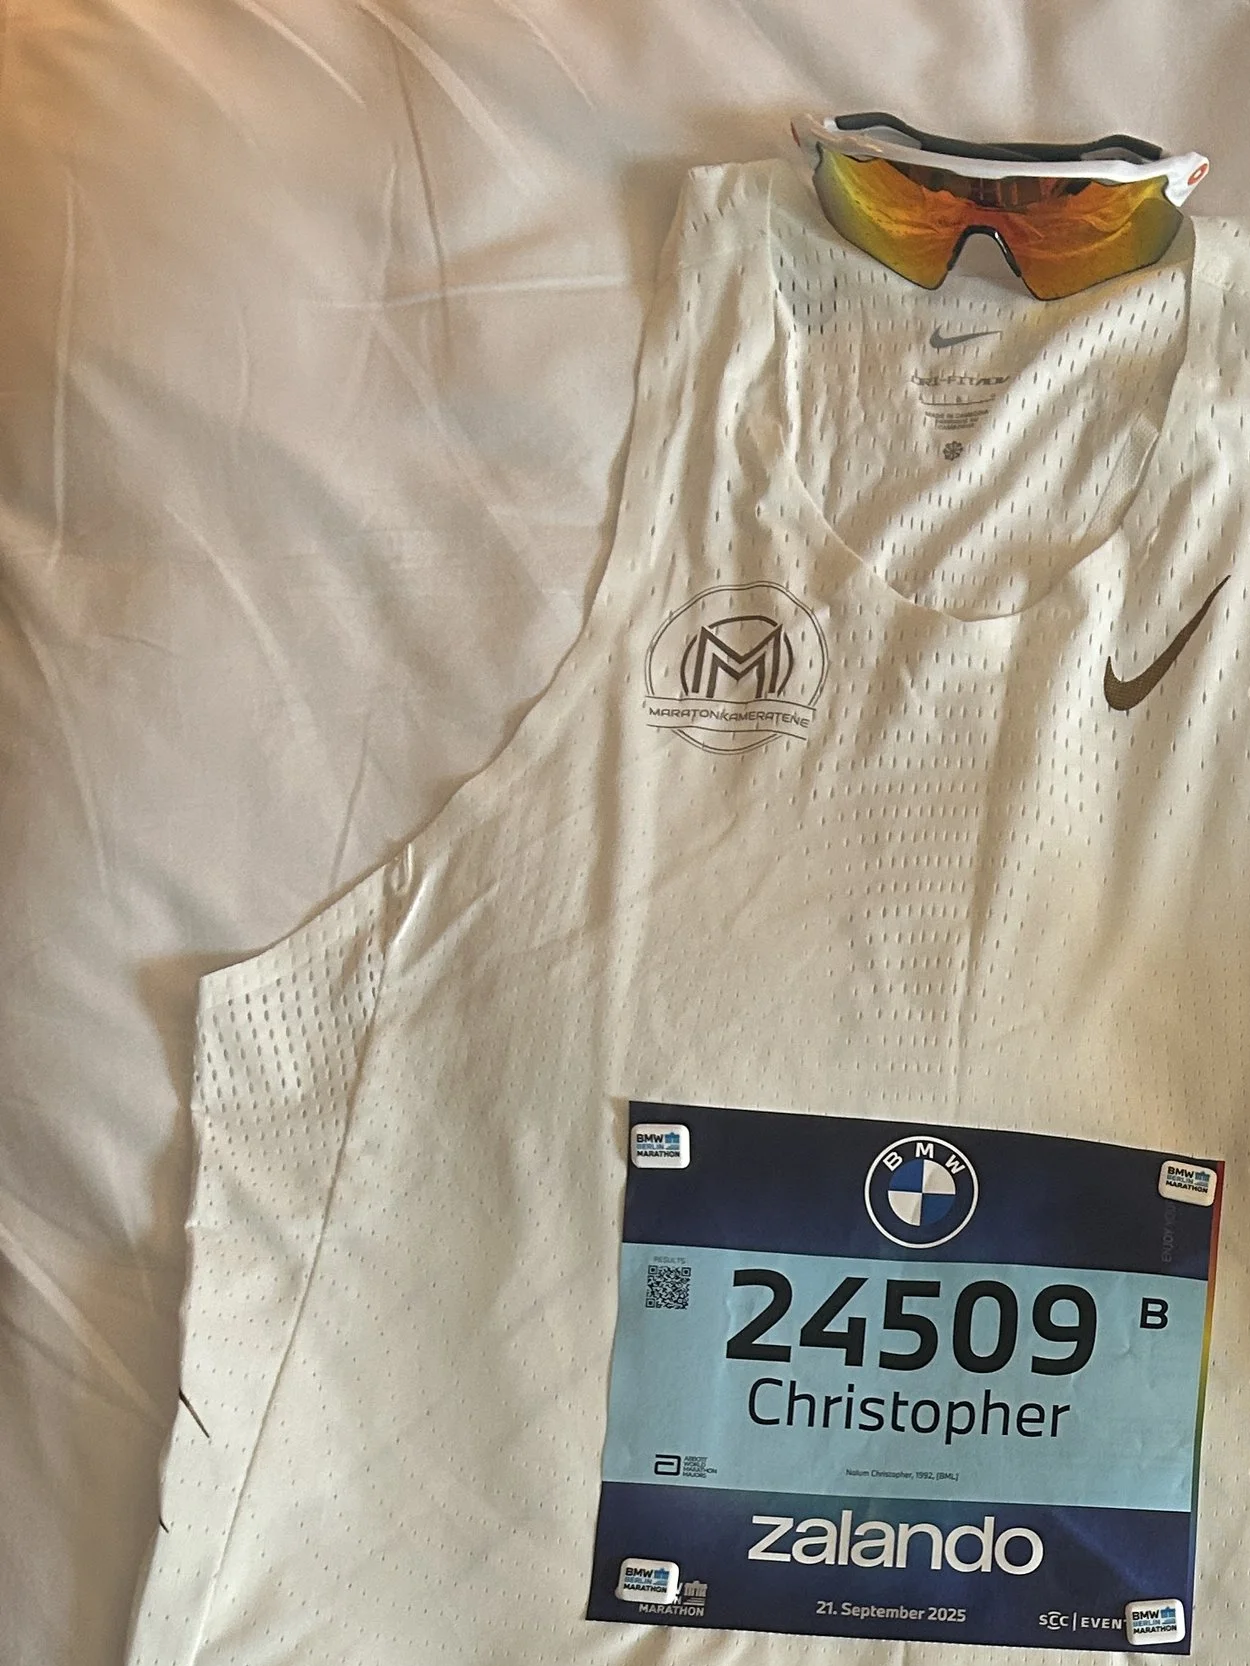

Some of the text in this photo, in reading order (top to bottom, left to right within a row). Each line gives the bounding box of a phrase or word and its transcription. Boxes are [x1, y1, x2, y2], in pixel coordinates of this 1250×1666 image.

[649, 707, 810, 728] MARATONKAMERATENE
[637, 1134, 663, 1142] BMW
[883, 1141, 966, 1176] BMW
[1167, 1166, 1194, 1178] BMW
[1167, 1175, 1194, 1184] BERLIN
[1166, 1180, 1208, 1193] MARATHON
[1140, 1297, 1170, 1330] B
[725, 1268, 1098, 1377] 24509
[748, 1377, 1071, 1445] Christopher
[747, 1510, 1044, 1575] zalando
[625, 1567, 653, 1577] BMW
[624, 1584, 667, 1593] MARATHON
[639, 1604, 704, 1616] MARATHON
[816, 1601, 967, 1622] 21. September 2025
[1132, 1610, 1159, 1620] BMW
[1081, 1617, 1126, 1630] EVEN
[1133, 1625, 1177, 1634] MARATHON
